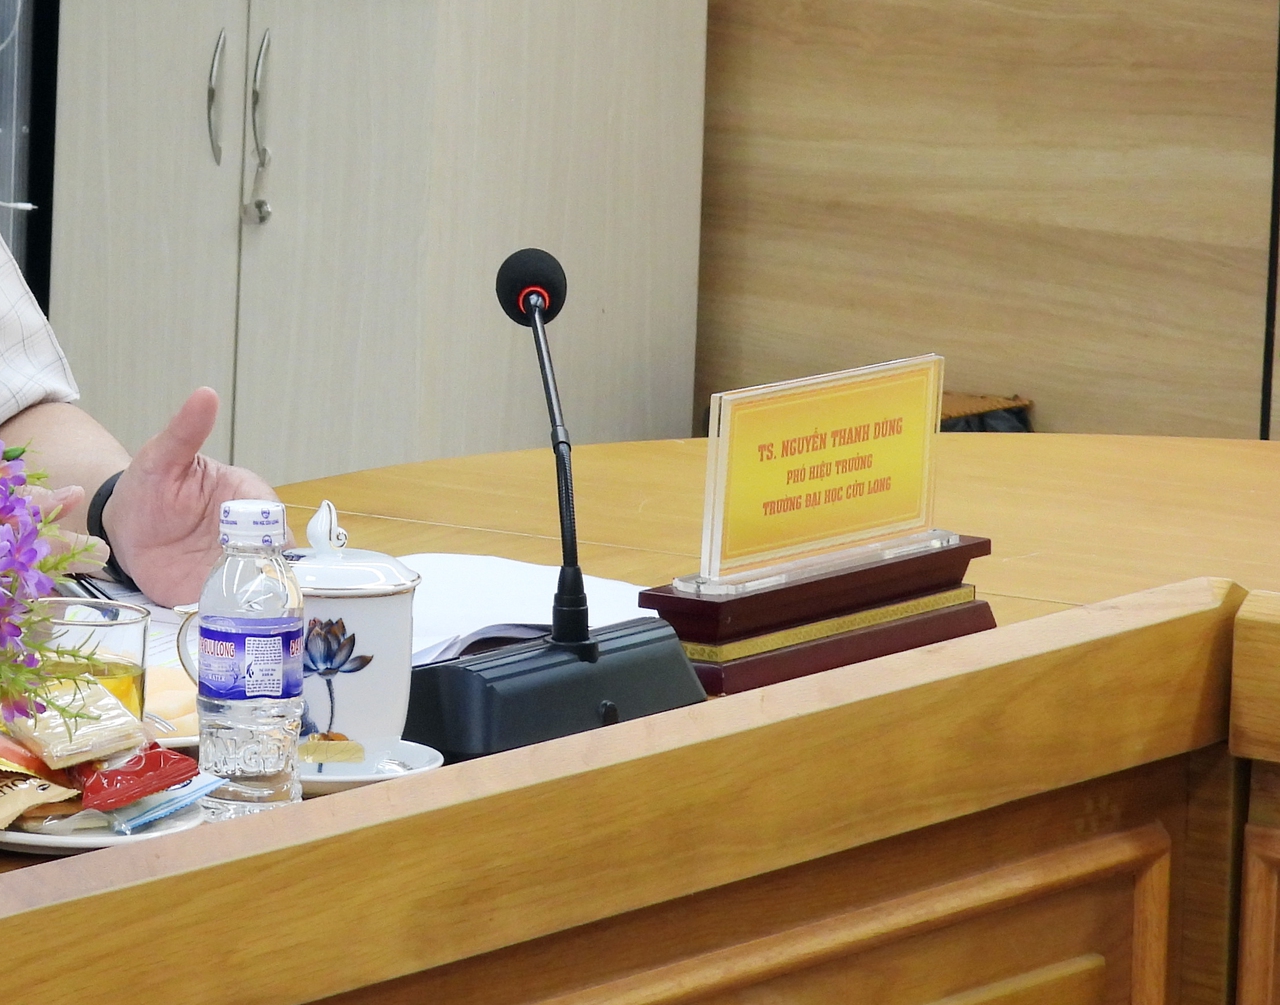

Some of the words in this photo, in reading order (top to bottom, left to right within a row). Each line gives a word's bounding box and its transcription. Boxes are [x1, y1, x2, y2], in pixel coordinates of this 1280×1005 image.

[757, 442, 777, 462] TS.
[780, 427, 827, 459] NGUYỄN
[830, 423, 870, 448] THANH
[867, 476, 891, 495] LONG
[216, 641, 235, 659] LONG
